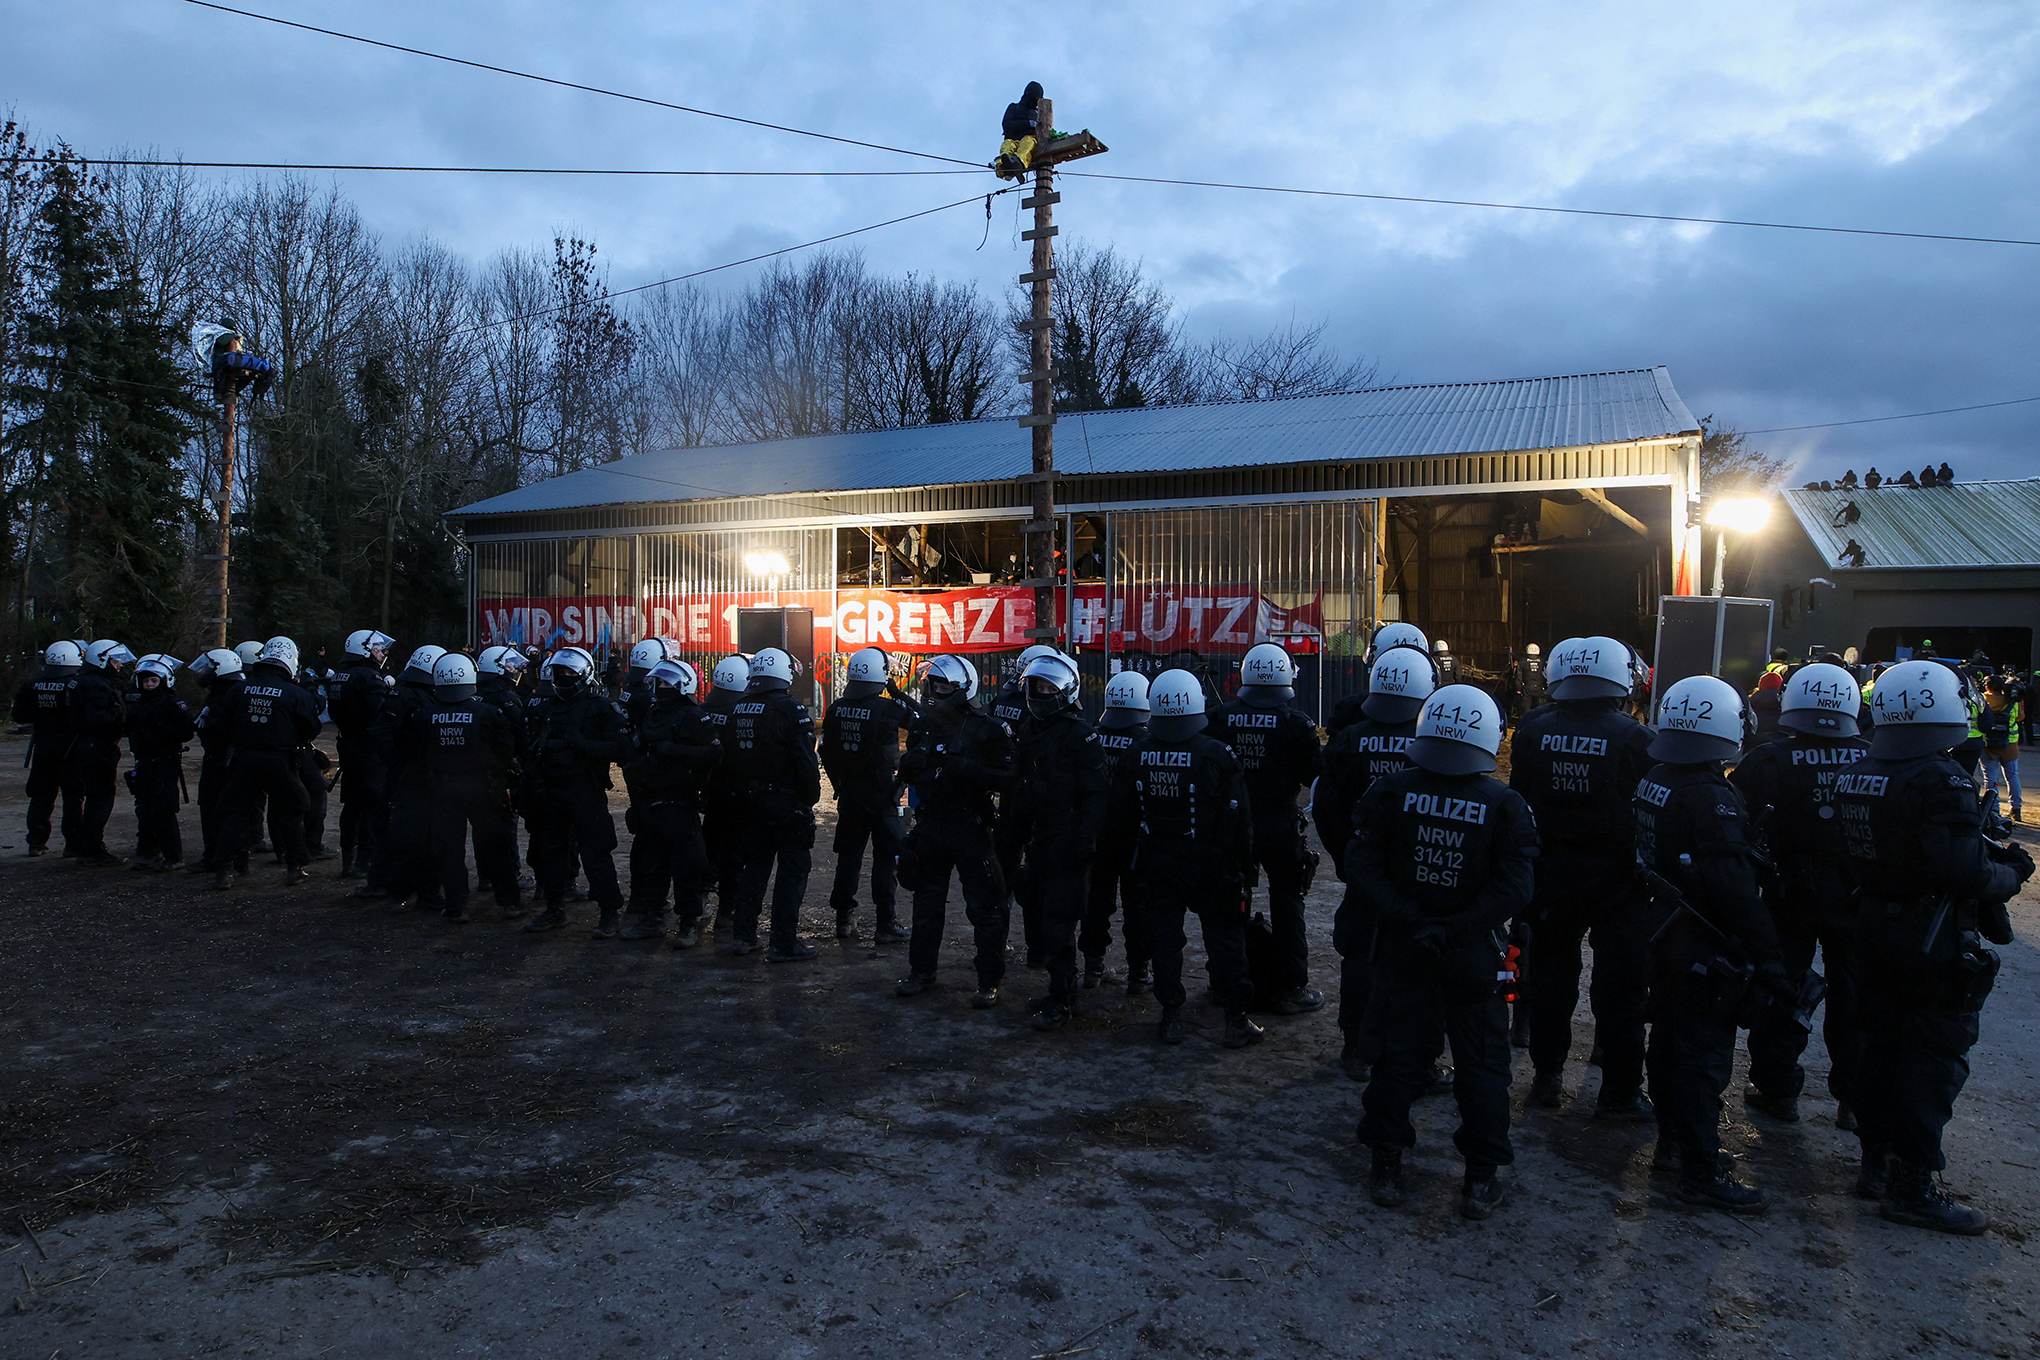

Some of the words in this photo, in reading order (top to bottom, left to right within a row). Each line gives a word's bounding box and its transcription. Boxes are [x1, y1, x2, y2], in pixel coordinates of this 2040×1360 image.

[485, 606, 552, 645] WIR
[562, 605, 648, 644] SIND
[653, 603, 711, 643] DIE
[1248, 659, 1286, 672] 14-1-2
[1569, 665, 1590, 674] NRW
[244, 686, 283, 698] POLIZEI
[1381, 682, 1405, 692] NRW
[1801, 679, 1852, 701] 14-1-1
[250, 698, 273, 707] NRW
[733, 703, 766, 715] POLIZEI
[1817, 698, 1842, 709] NRW
[247, 706, 273, 716] 31423
[835, 706, 872, 721] POLIZEI
[993, 704, 1022, 721] POLIZEI
[1163, 707, 1185, 715] NRW
[1427, 702, 1482, 730] 14-1-2
[1882, 710, 1915, 722] NRW
[431, 712, 474, 725] POLIZEI
[737, 718, 755, 728] NRW
[1227, 713, 1278, 729] POLIZEI
[1668, 717, 1699, 729] NRW
[439, 727, 464, 737] NRW
[840, 720, 862, 732] NRW
[1435, 724, 1467, 740] NRW
[440, 738, 466, 747] 31413
[839, 731, 862, 743] 31413
[1236, 733, 1266, 745] NRW
[1358, 735, 1416, 753] POLIZE
[1540, 734, 1609, 757] POLIZEI
[1236, 745, 1266, 757] 31412
[1140, 751, 1192, 768] POLIZEI
[1243, 758, 1260, 770] RH
[1369, 760, 1405, 774] NRW
[1552, 761, 1590, 778] NRW
[1149, 771, 1180, 785] NRW
[1149, 785, 1180, 798] 31411
[1552, 777, 1590, 793] 31411
[1833, 774, 1889, 797] POLIZEI
[1402, 792, 1487, 826] POLIZEI
[1841, 803, 1870, 822] NRW
[1416, 825, 1466, 849] NRW
[1413, 845, 1464, 870] 31412
[1415, 865, 1459, 888] BeSi
